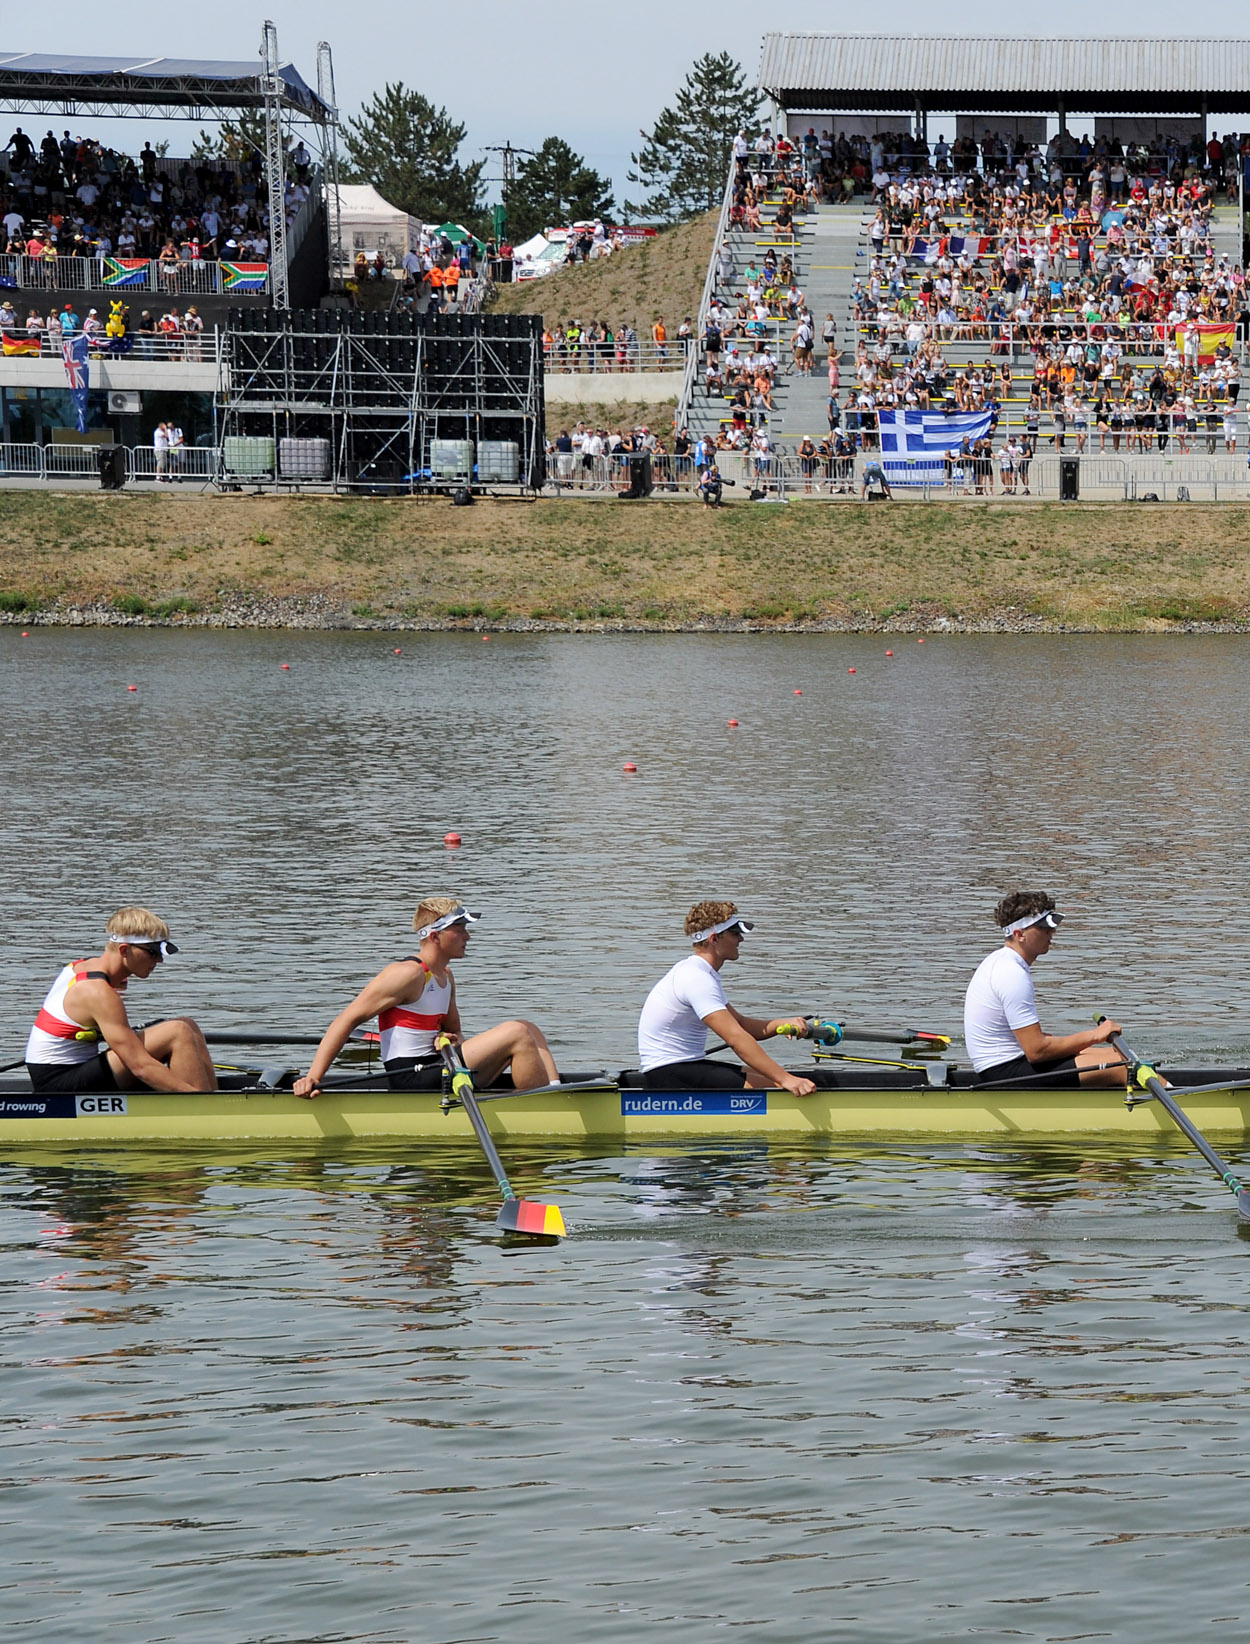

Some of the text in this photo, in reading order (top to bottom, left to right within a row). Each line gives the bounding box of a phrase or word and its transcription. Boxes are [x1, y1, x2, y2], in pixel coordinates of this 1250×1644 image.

[6, 1103, 46, 1113] rowing
[80, 1098, 124, 1112] GER
[624, 1096, 755, 1111] rudern.de DRV
